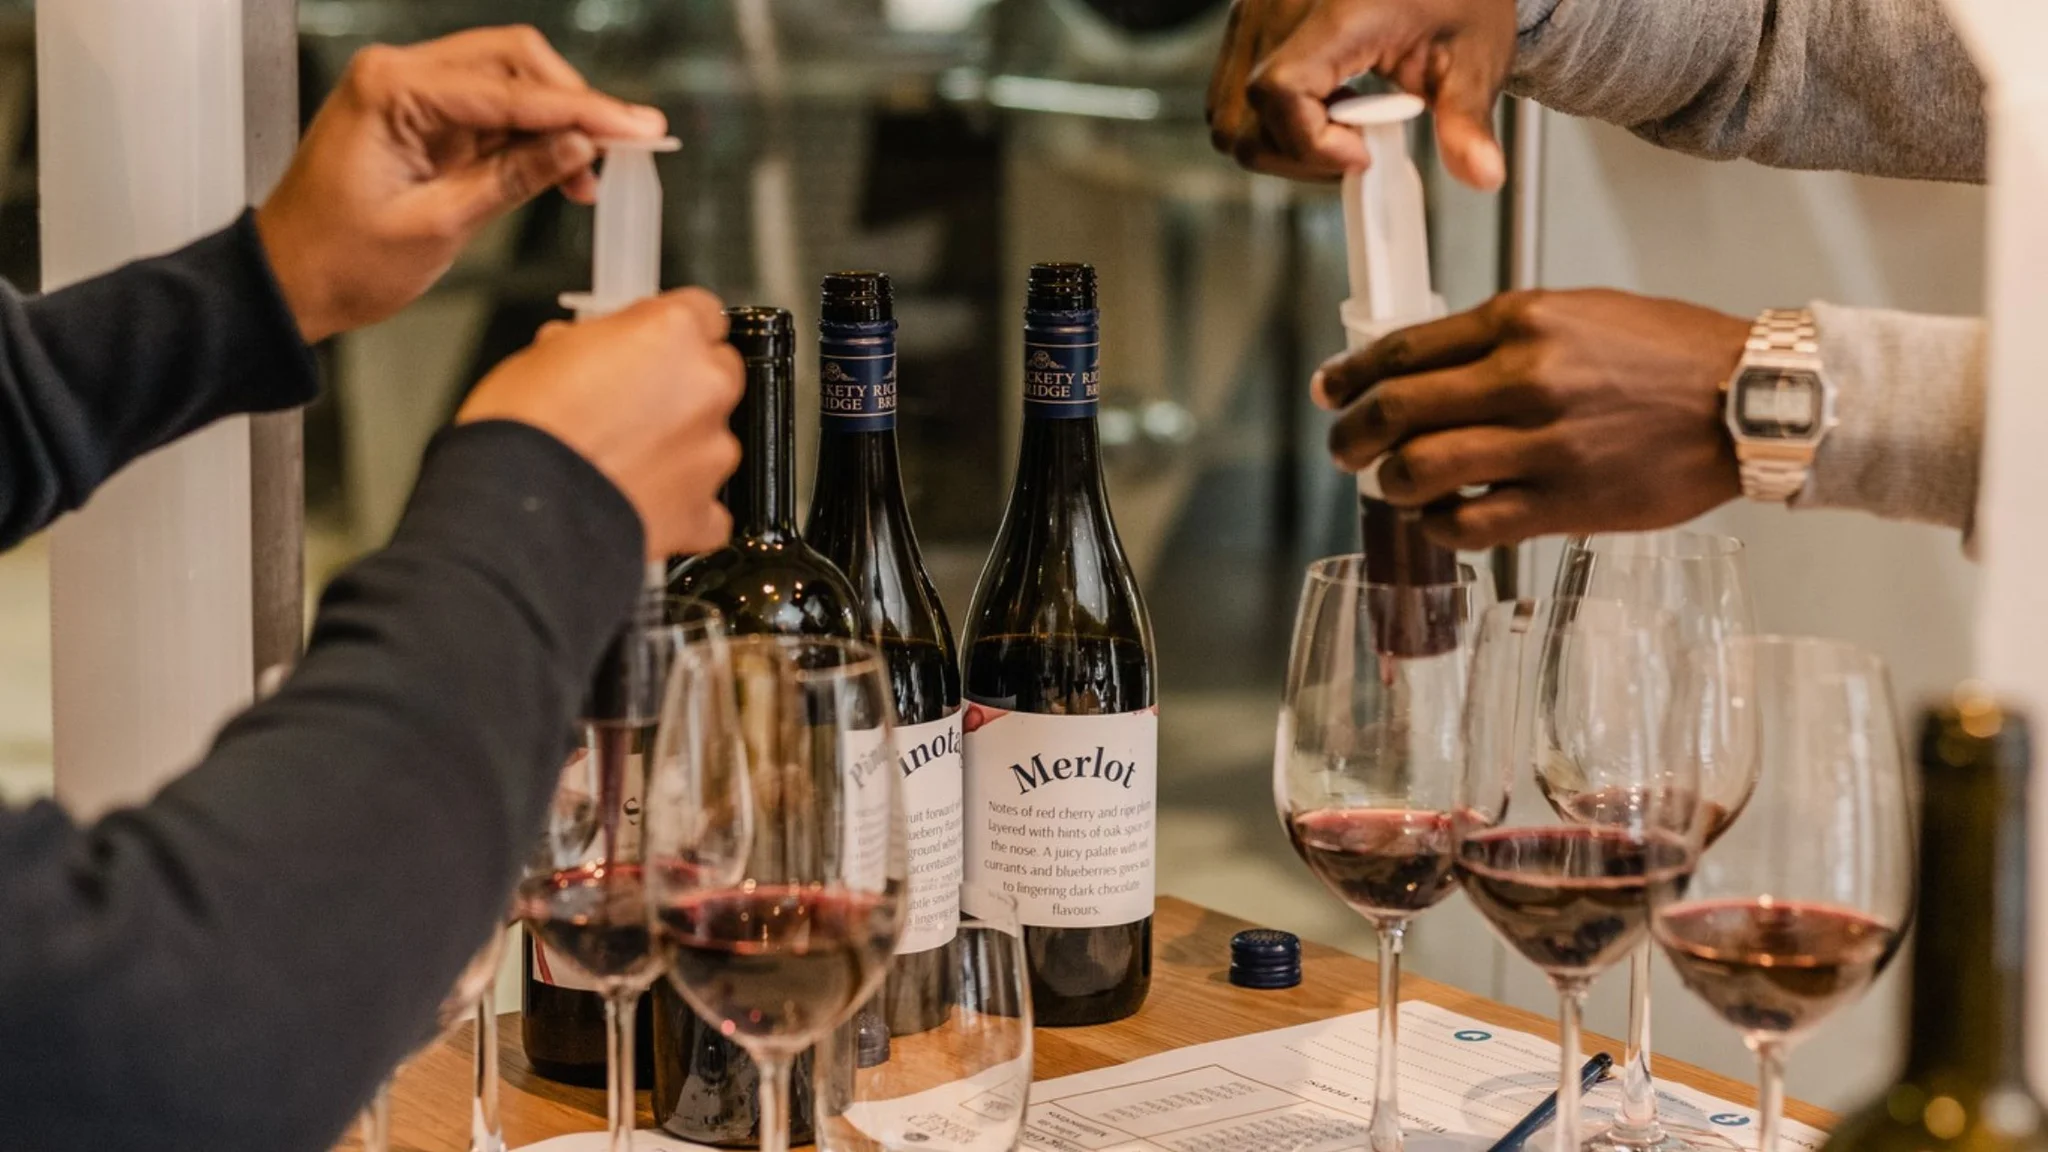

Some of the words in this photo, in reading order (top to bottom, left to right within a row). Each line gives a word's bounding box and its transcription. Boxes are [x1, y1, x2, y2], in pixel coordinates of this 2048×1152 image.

[1010, 747, 1136, 795] Merlot
[988, 801, 1018, 815] Notes
[1021, 803, 1033, 817] of
[1036, 805, 1056, 819] red
[1059, 807, 1095, 822] cherry
[1098, 805, 1117, 819] and
[988, 819, 1026, 838] layered
[1028, 827, 1054, 838] with
[1057, 827, 1087, 839] hints
[1089, 824, 1101, 838] of
[1103, 824, 1121, 838] oak
[991, 840, 1007, 853] the
[1010, 845, 1037, 857] nose.
[1043, 846, 1052, 857] A
[1054, 846, 1082, 861] juicy
[1085, 845, 1118, 860] palate
[984, 858, 1027, 875] currants
[1030, 865, 1053, 877] and
[1056, 864, 1117, 878] blueberries
[1003, 881, 1015, 892] to
[1016, 882, 1067, 899] lingering
[1069, 884, 1095, 896] dark
[1098, 879, 1141, 896] chocolate
[1052, 903, 1101, 916] flavours.
